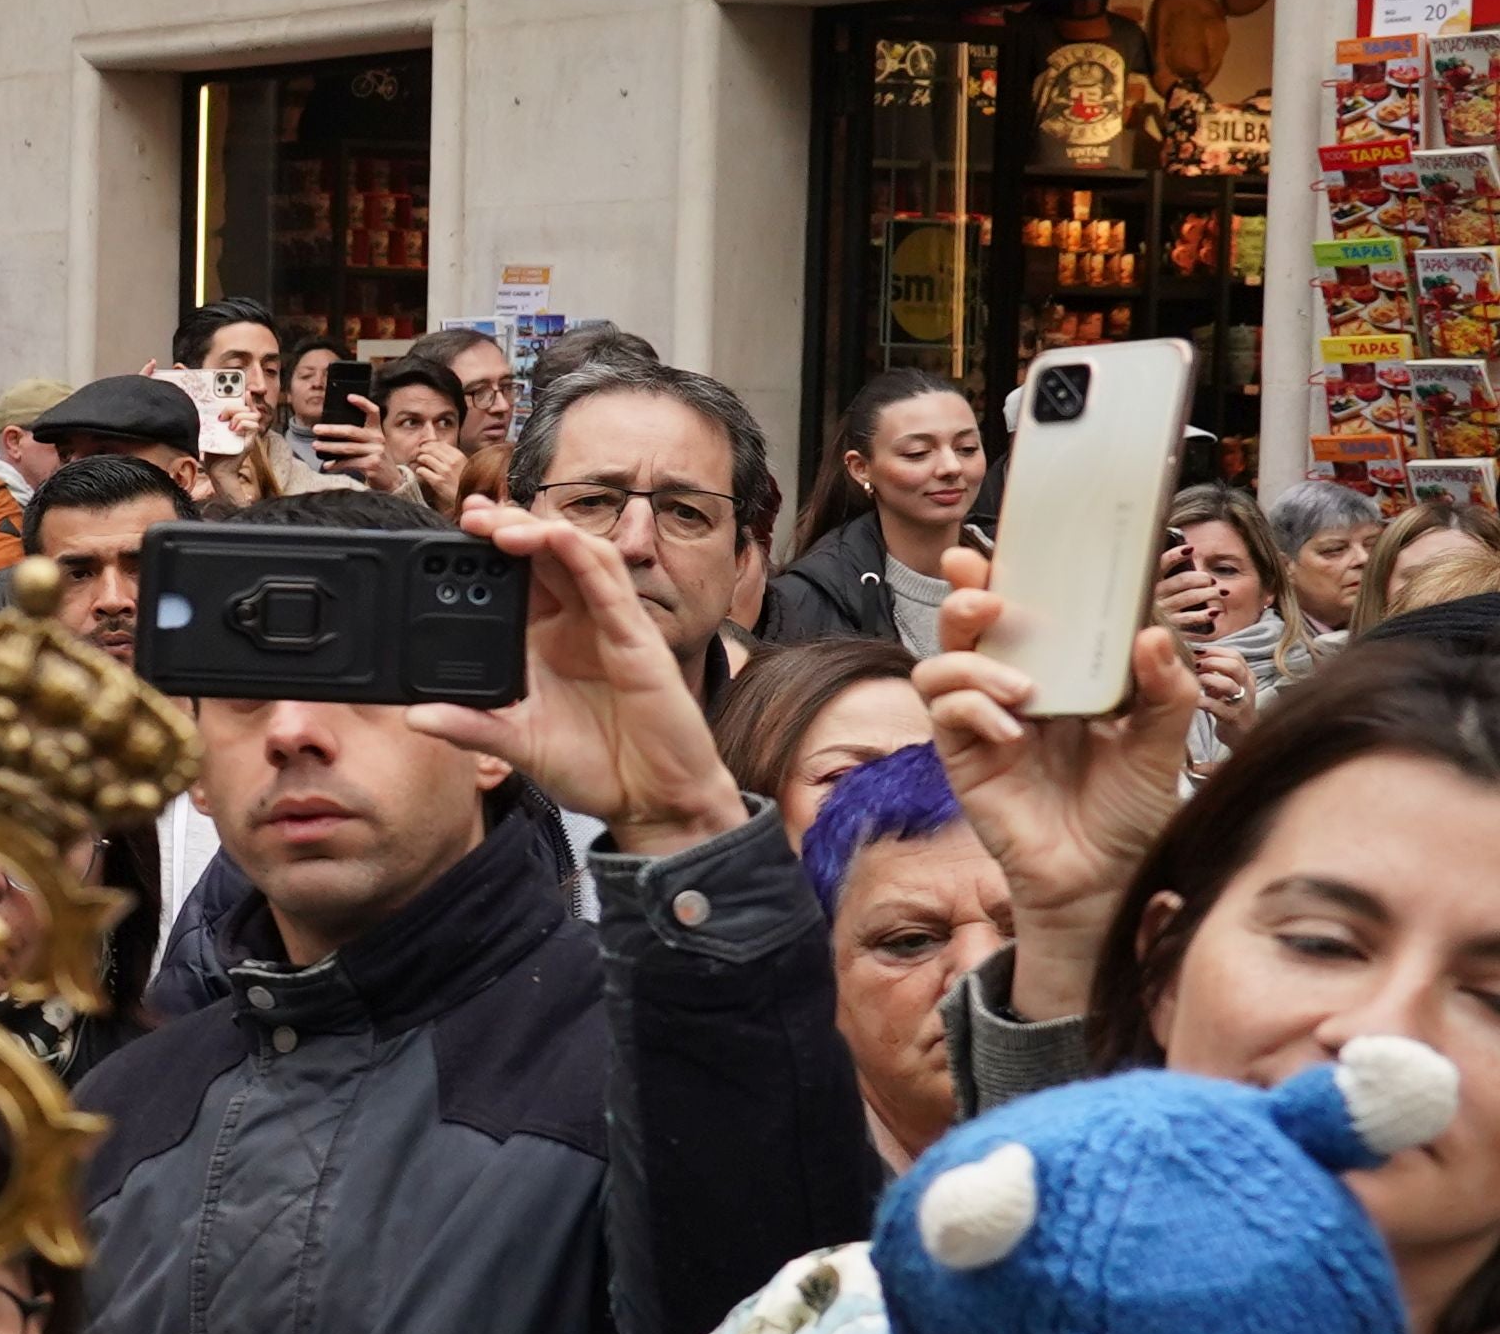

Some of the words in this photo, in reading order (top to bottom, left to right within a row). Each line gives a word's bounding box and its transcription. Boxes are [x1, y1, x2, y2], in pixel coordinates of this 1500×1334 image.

[1424, 4, 1448, 22] 20
[1362, 39, 1412, 55] TAPAS
[1350, 146, 1405, 163] TAPAS
[1341, 245, 1393, 259] TAPAS
[1350, 342, 1399, 357] TAPAS
[1339, 442, 1389, 455] TAPAS
